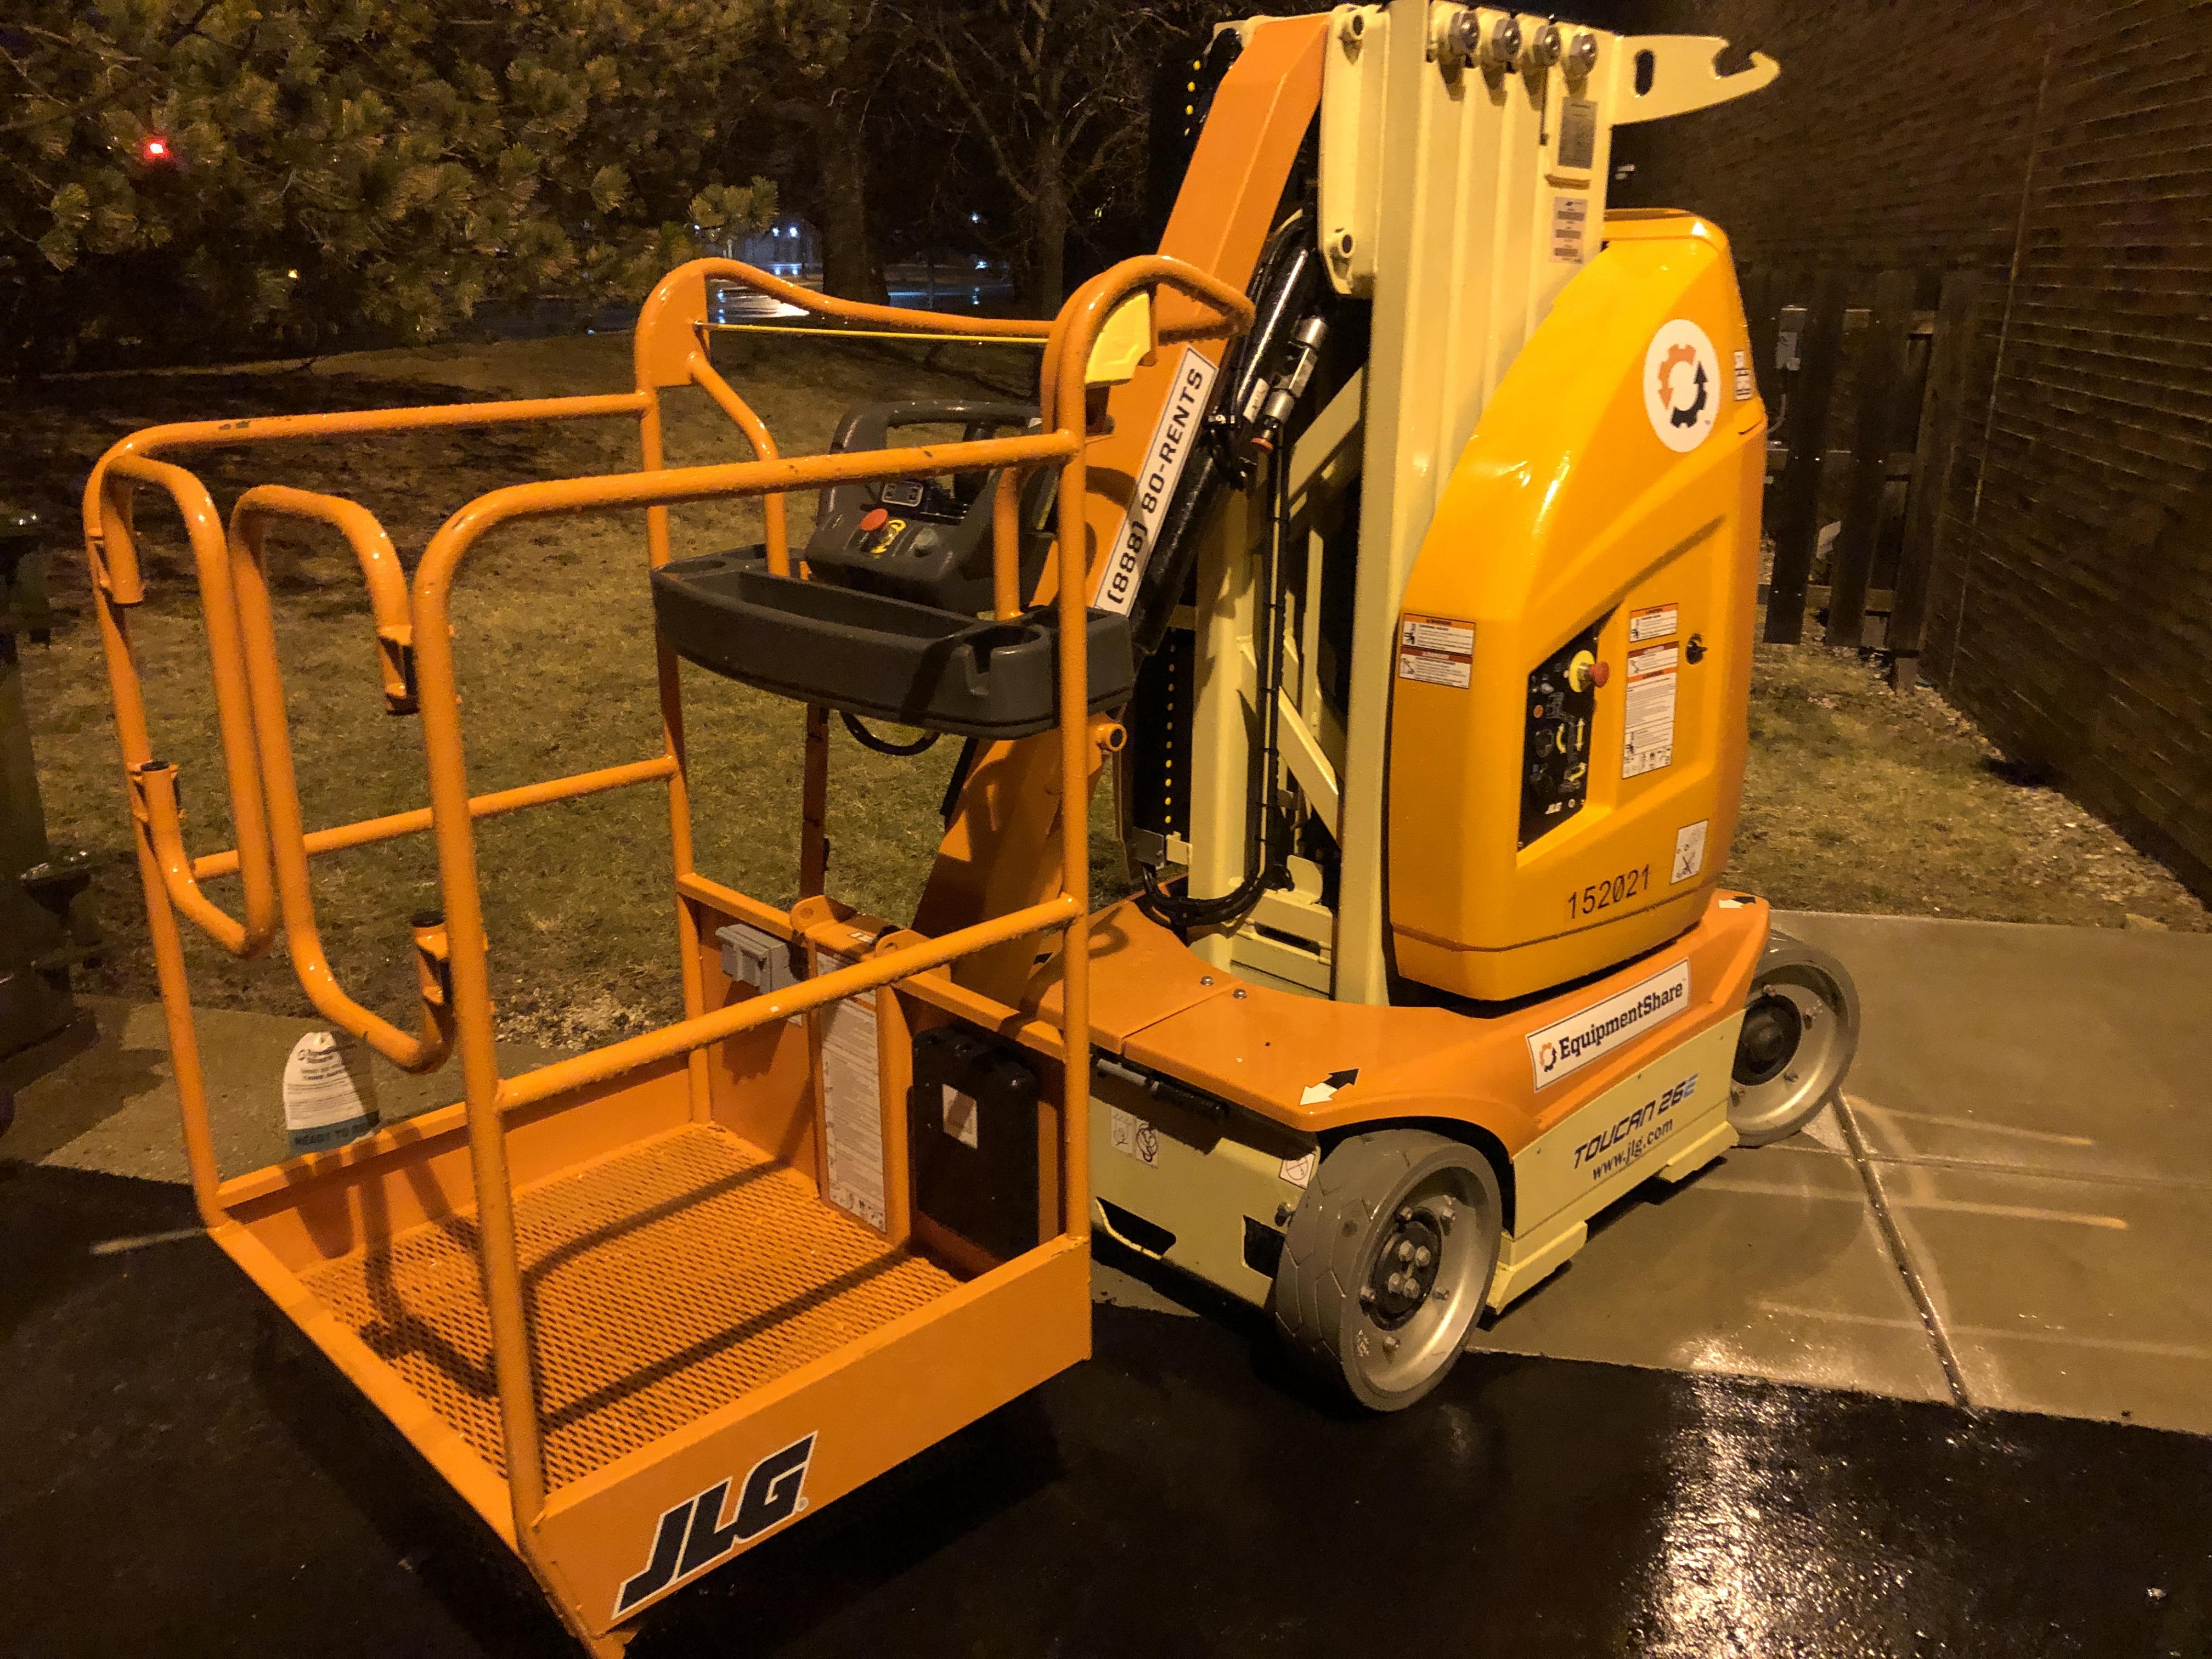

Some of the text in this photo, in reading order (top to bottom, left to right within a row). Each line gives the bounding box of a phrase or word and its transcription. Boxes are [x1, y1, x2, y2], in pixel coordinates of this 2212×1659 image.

[1107, 368, 1204, 605] (888) 80-RENTS
[1568, 864, 1650, 919] 152021
[1559, 982, 1683, 1060] EquipmentShare
[1573, 1073, 1699, 1170] TOUCAN 26E
[1592, 1118, 1674, 1181] www.jlg.com
[611, 1429, 819, 1621] JLG
